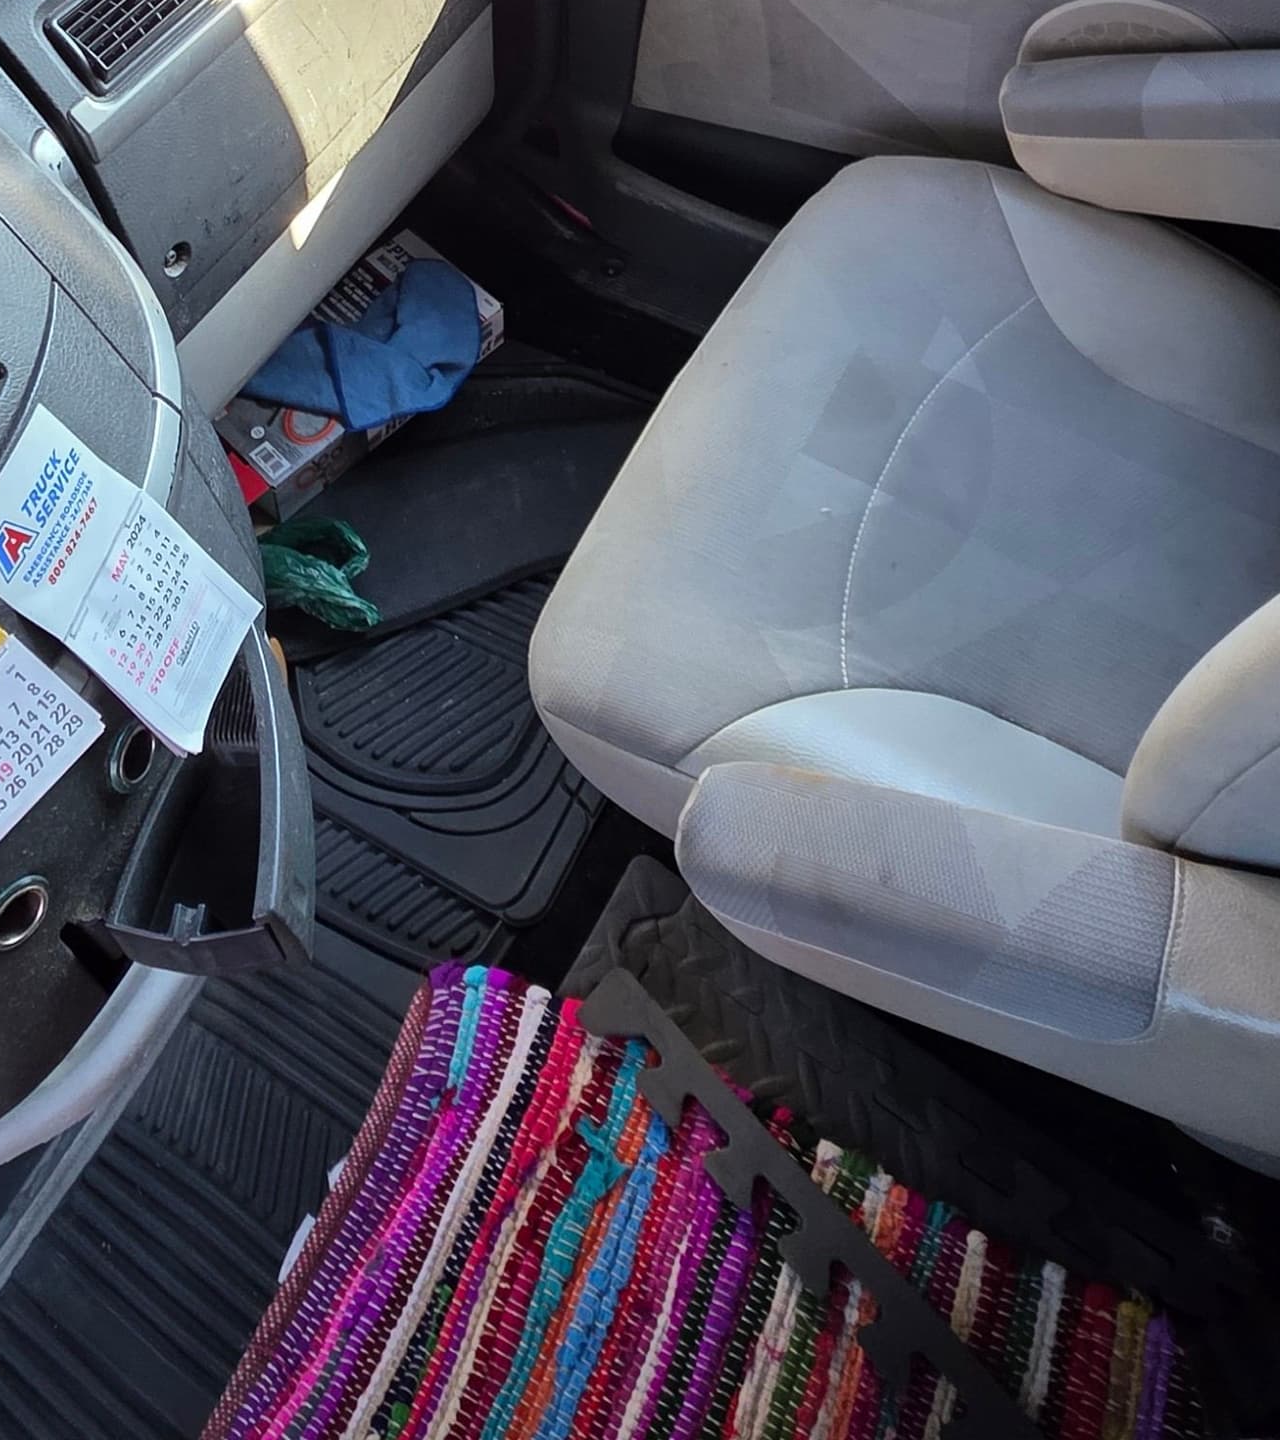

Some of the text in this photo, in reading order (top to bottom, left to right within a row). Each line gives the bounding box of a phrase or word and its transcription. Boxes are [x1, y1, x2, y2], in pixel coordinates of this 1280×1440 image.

[21, 449, 61, 517] TRUCK
[36, 448, 80, 528] SERVICE
[23, 472, 88, 583] EMERGENCY ROADSIDE
[33, 526, 70, 587] ASSISTANCE
[48, 498, 98, 585] 800-824-7467
[112, 515, 146, 582] MAY 2024
[152, 552, 163, 567] 10
[161, 536, 170, 549] 11
[118, 544, 180, 668] 12 13 14 15 16 17 18
[126, 552, 189, 676] 19 20 21 22 23 24 25
[144, 651, 153, 667] 27
[153, 632, 163, 649] 28
[162, 614, 172, 630] 29
[172, 596, 181, 612] 30
[180, 580, 189, 595] 31
[14, 672, 26, 682] 1
[164, 638, 179, 668] OFF
[0, 730, 20, 750] 13
[18, 710, 39, 730] 14
[37, 690, 57, 710] 15
[8, 702, 20, 716] 7
[27, 682, 41, 696] 8
[5, 775, 27, 798] 26
[24, 754, 45, 778] 27
[44, 734, 65, 757] 28
[62, 714, 84, 737] 29
[12, 742, 33, 765] 20
[30, 724, 51, 745] 21
[50, 702, 71, 725] 22
